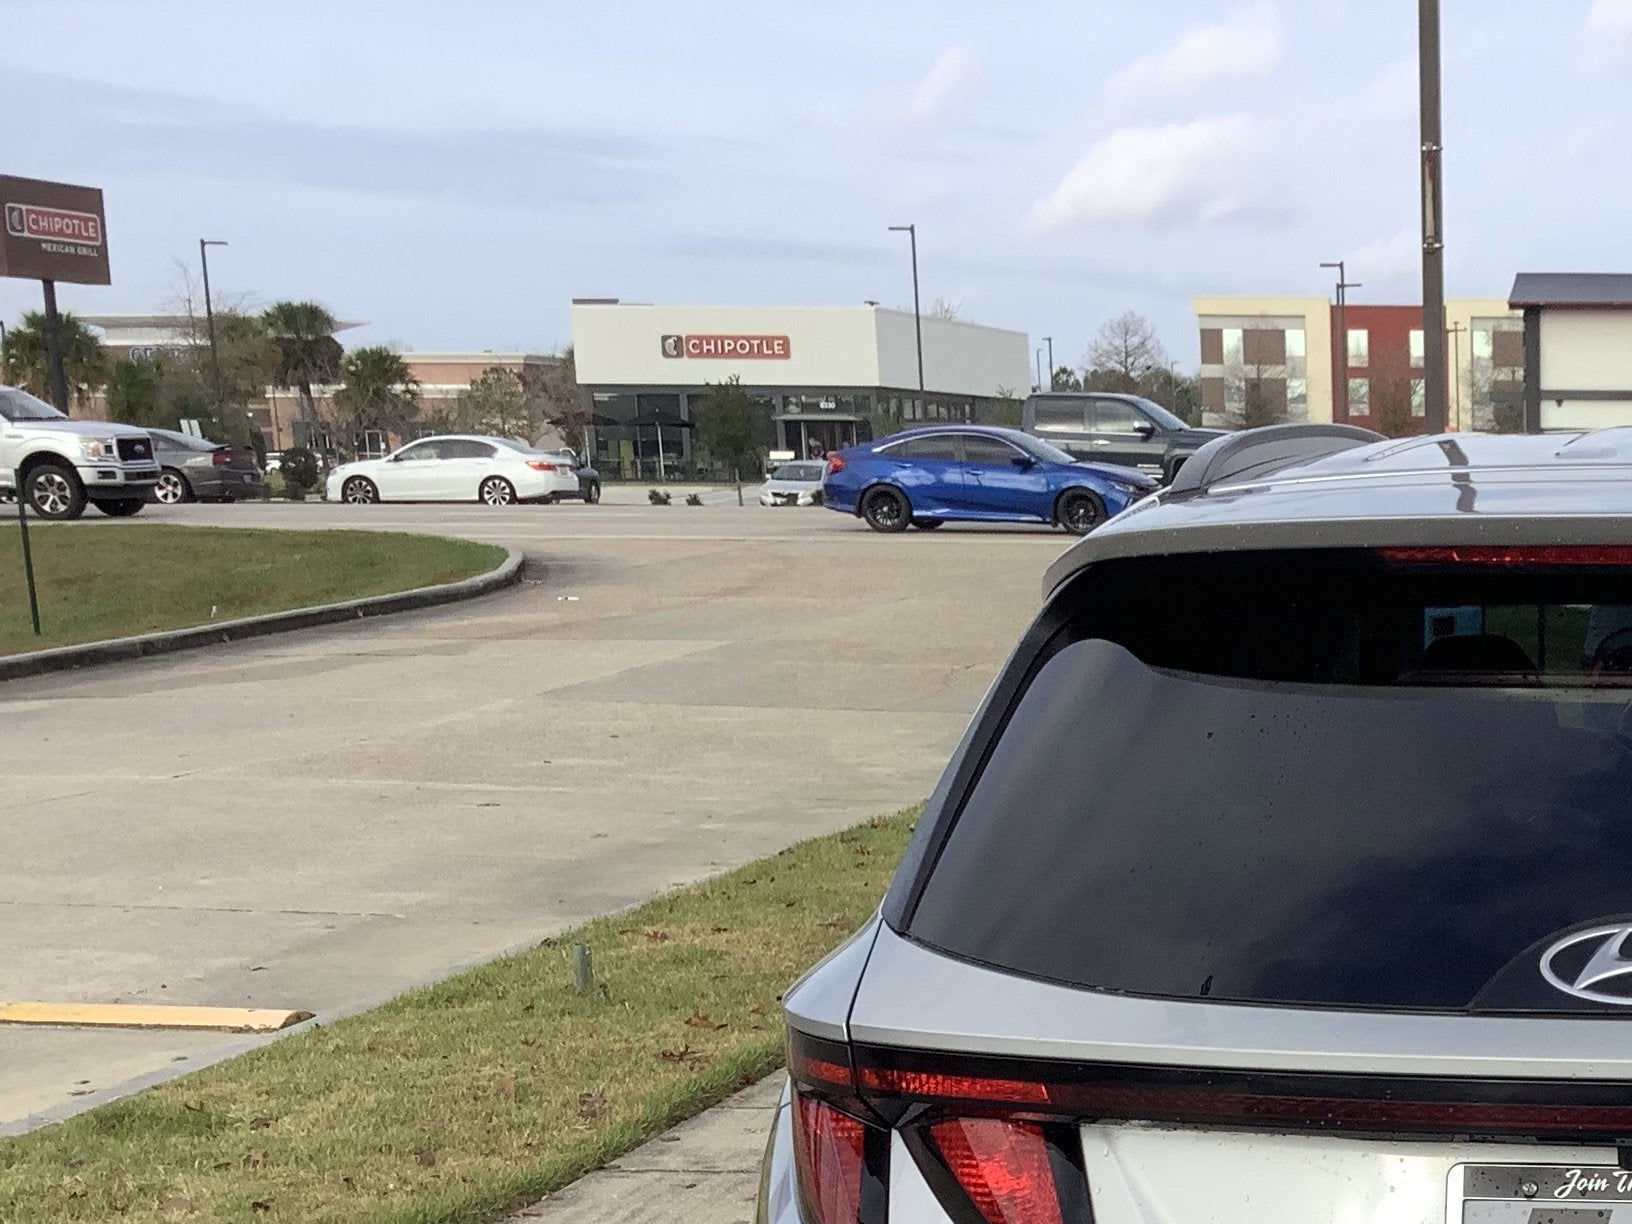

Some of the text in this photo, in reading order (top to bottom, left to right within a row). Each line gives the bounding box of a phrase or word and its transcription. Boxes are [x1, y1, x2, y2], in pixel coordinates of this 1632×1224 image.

[28, 213, 97, 237] CHIPOTLE
[41, 242, 99, 257] MEXICAN GRILL
[688, 339, 785, 355] CHIPOTLE
[1553, 1169, 1610, 1199] Join
